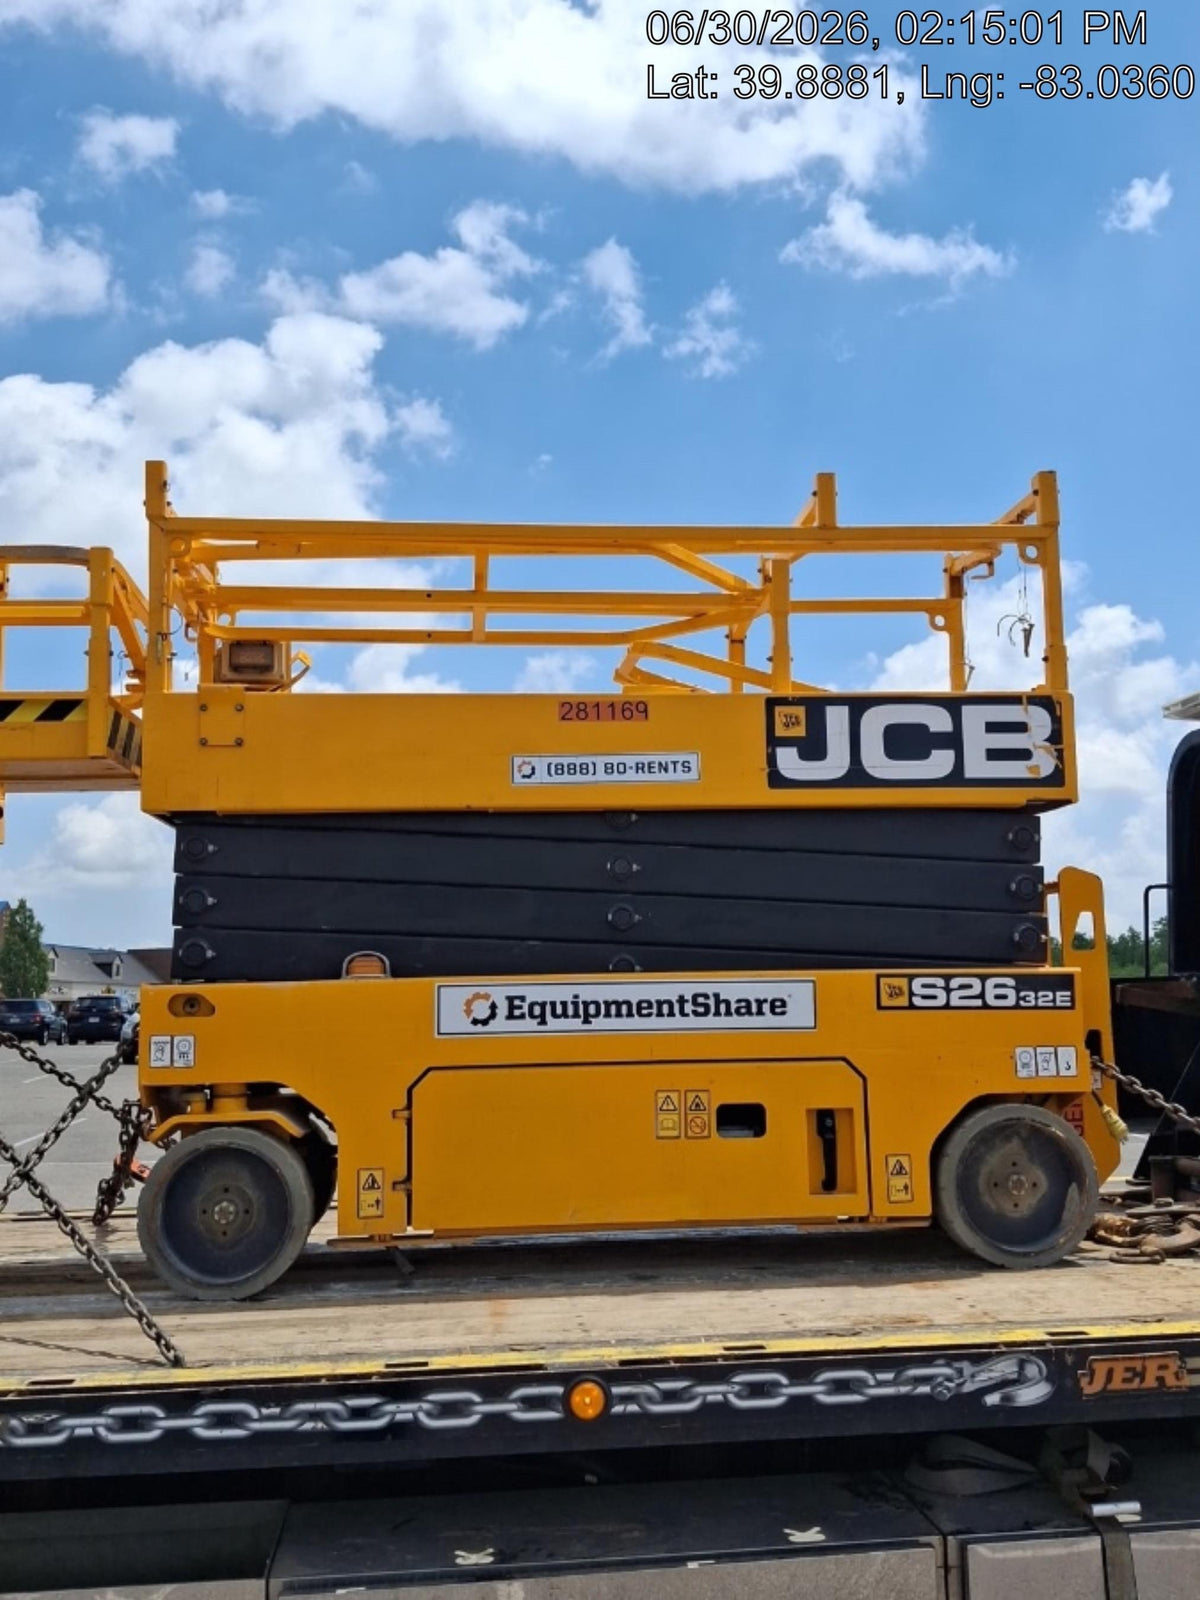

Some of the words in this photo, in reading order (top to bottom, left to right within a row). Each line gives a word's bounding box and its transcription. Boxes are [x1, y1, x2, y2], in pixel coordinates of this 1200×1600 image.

[560, 701, 649, 721] 281169
[775, 703, 1056, 780] JCB
[547, 762, 597, 777] (888)
[603, 760, 692, 775] 80-RENTS
[504, 993, 788, 1026] EquipmentShare
